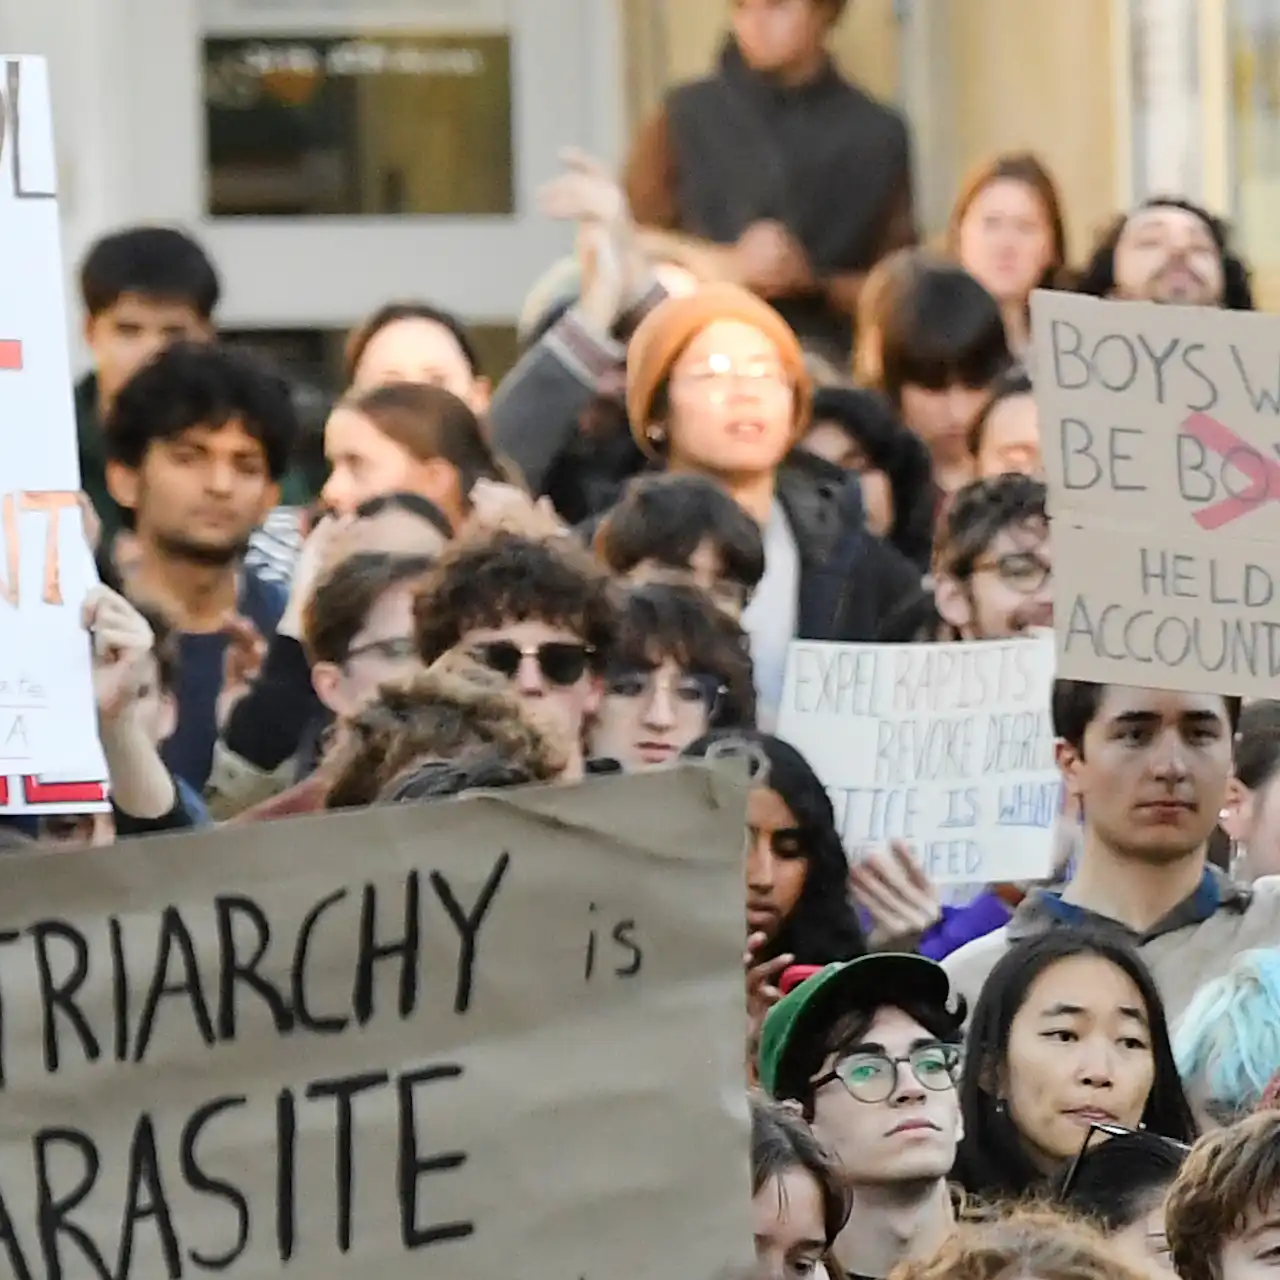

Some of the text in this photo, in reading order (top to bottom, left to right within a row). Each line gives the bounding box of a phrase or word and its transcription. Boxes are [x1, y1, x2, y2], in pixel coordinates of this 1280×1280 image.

[1051, 320, 1219, 413] BOYS
[1060, 418, 1280, 503] BE BO
[1140, 547, 1273, 608] HELD
[793, 646, 1032, 717] EXPEL RAPISTS
[874, 716, 976, 784] REVOKE
[836, 784, 919, 842] TICE
[938, 786, 982, 828] IS
[583, 902, 643, 981] is
